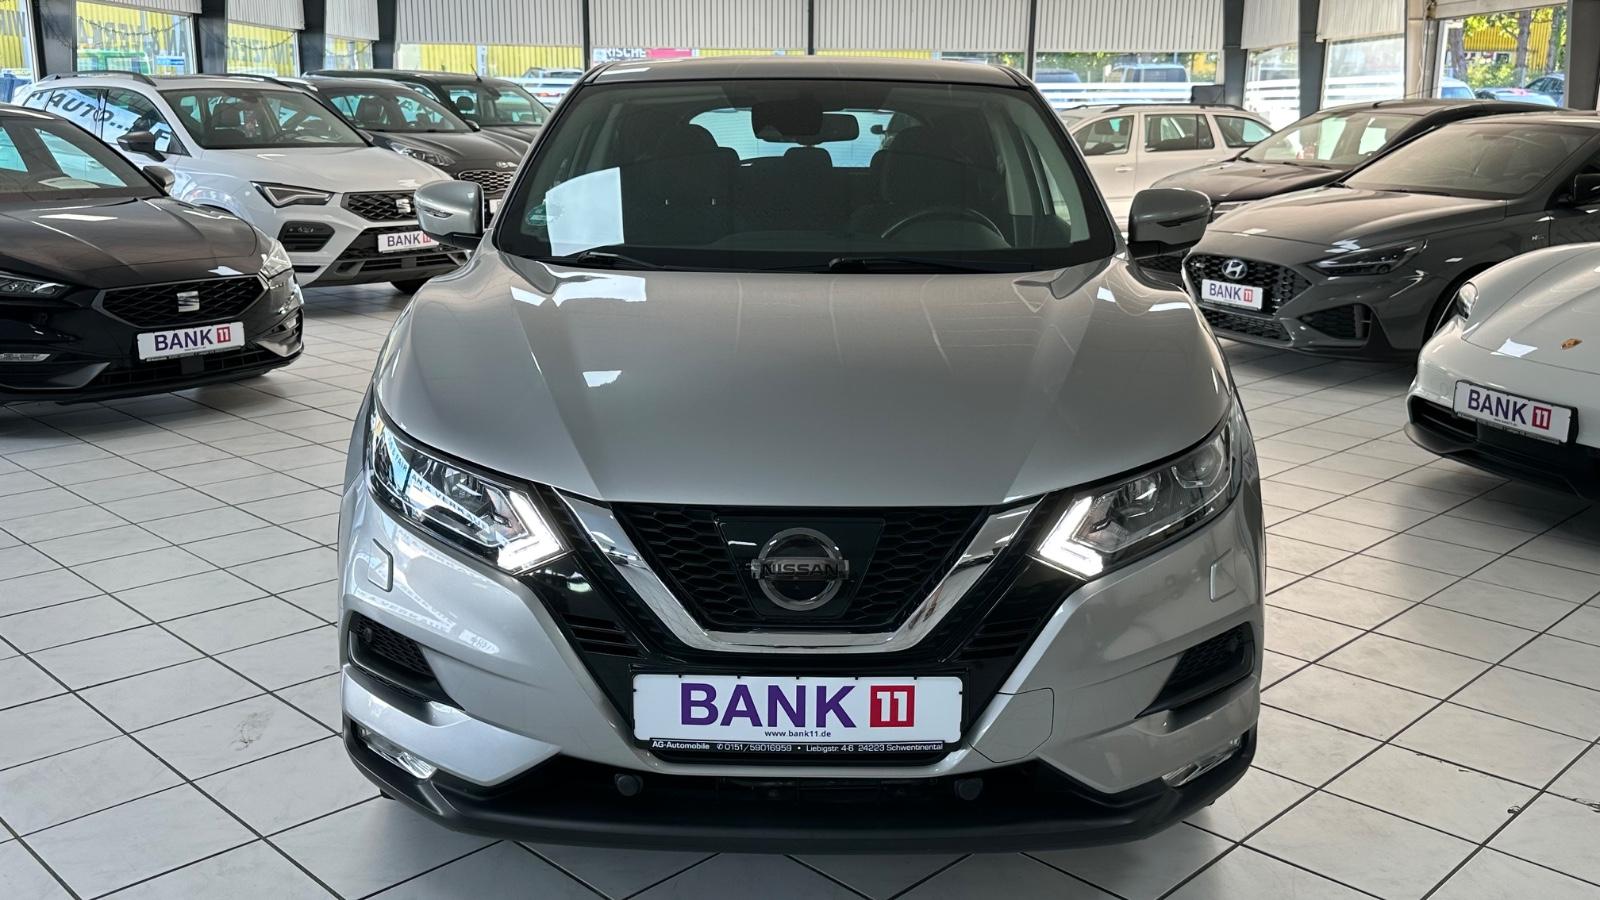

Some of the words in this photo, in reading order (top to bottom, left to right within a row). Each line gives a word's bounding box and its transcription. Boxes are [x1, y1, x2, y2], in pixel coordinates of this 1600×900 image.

[387, 233, 420, 247] BANK
[1209, 283, 1241, 301] BANK
[154, 328, 213, 351] BANK
[218, 327, 230, 342] 11
[1468, 388, 1528, 425] BANK
[1533, 408, 1550, 428] 11
[762, 563, 838, 576] NISSAN
[681, 683, 856, 728] BANK
[874, 689, 910, 724] 11
[765, 730, 831, 738] www.bank11.de
[652, 740, 710, 750] AG-Automobile
